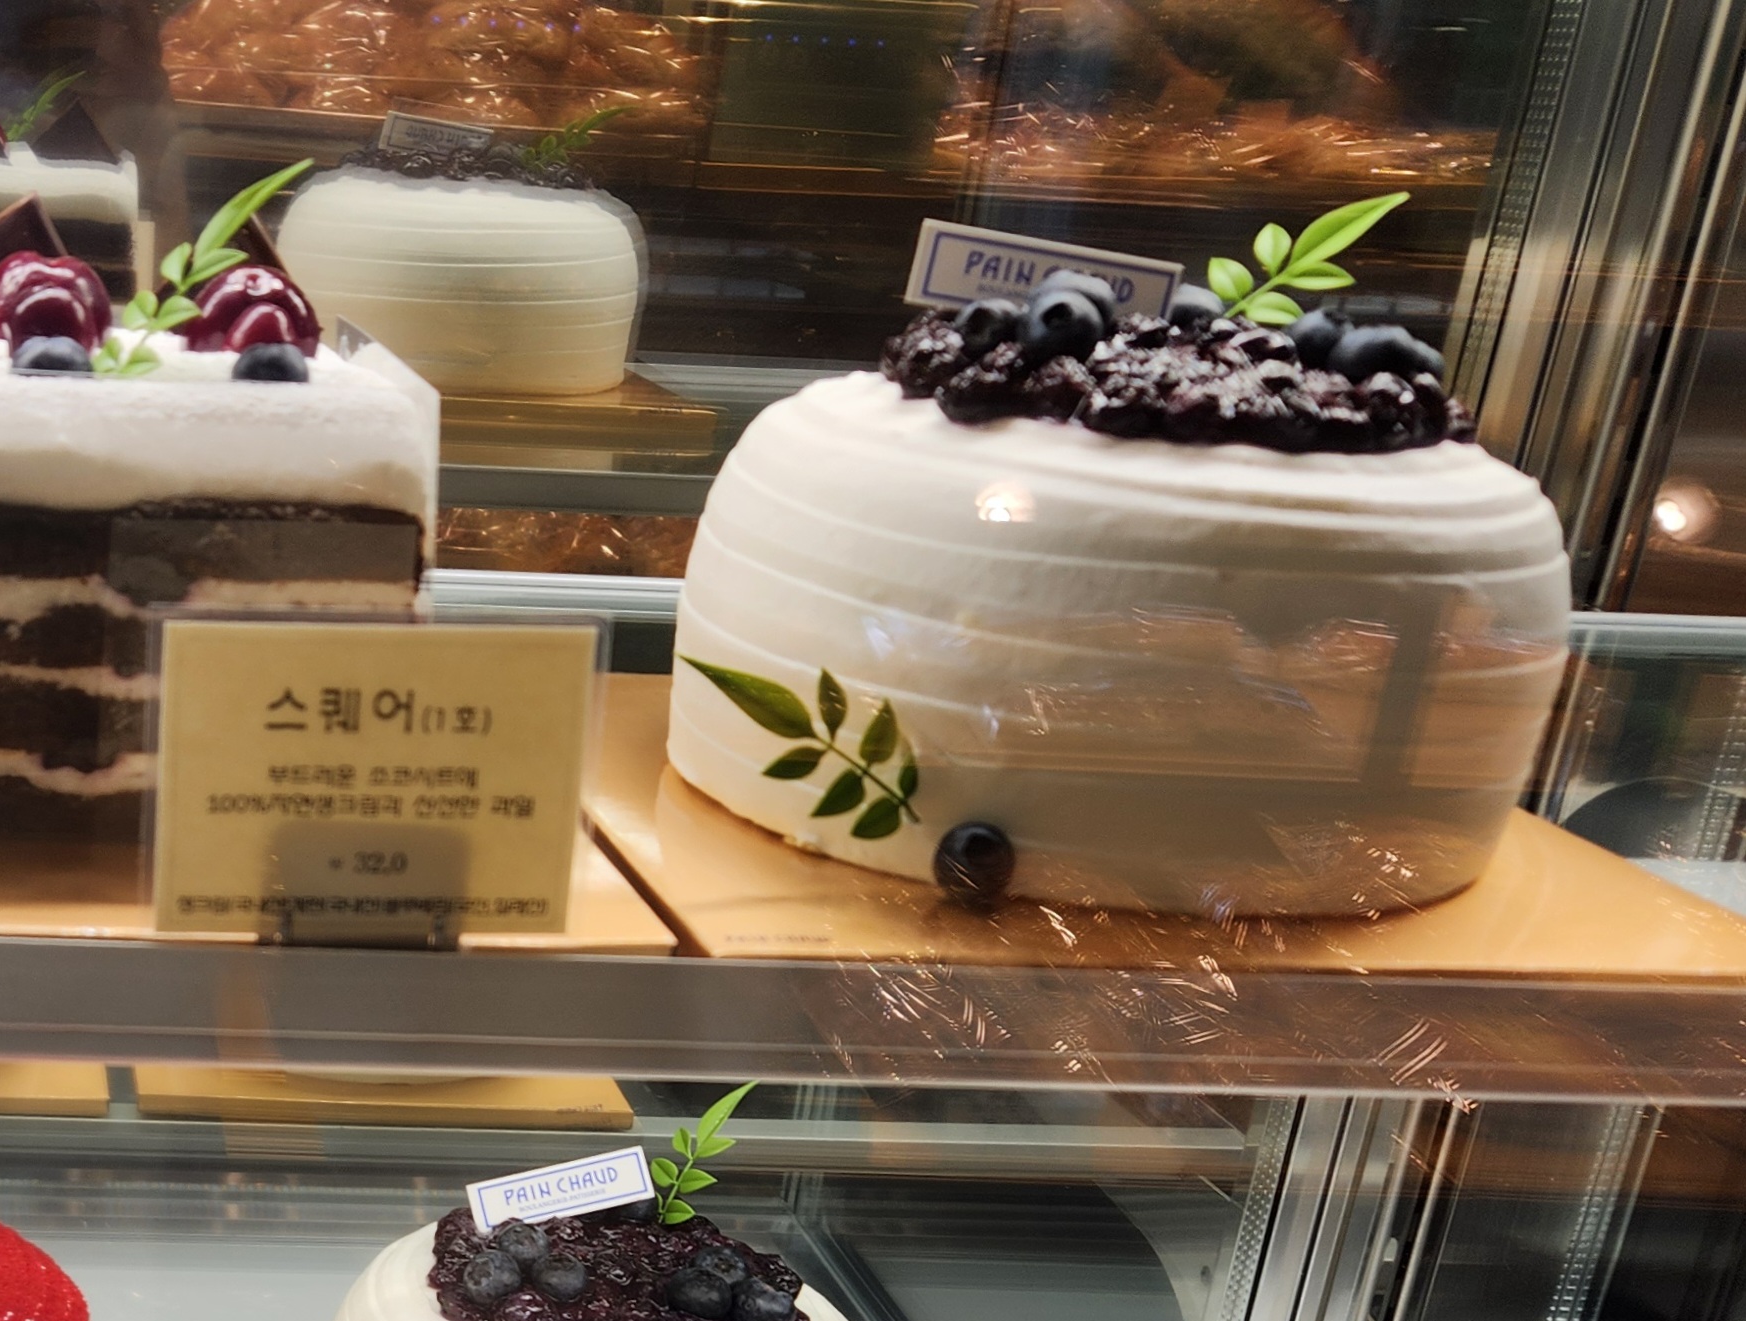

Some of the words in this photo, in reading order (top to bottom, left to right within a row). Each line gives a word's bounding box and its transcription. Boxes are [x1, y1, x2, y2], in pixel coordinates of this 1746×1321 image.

[964, 250, 1036, 286] PAIN
[503, 1181, 552, 1206] PAIN
[556, 1166, 618, 1194] CHAUD
